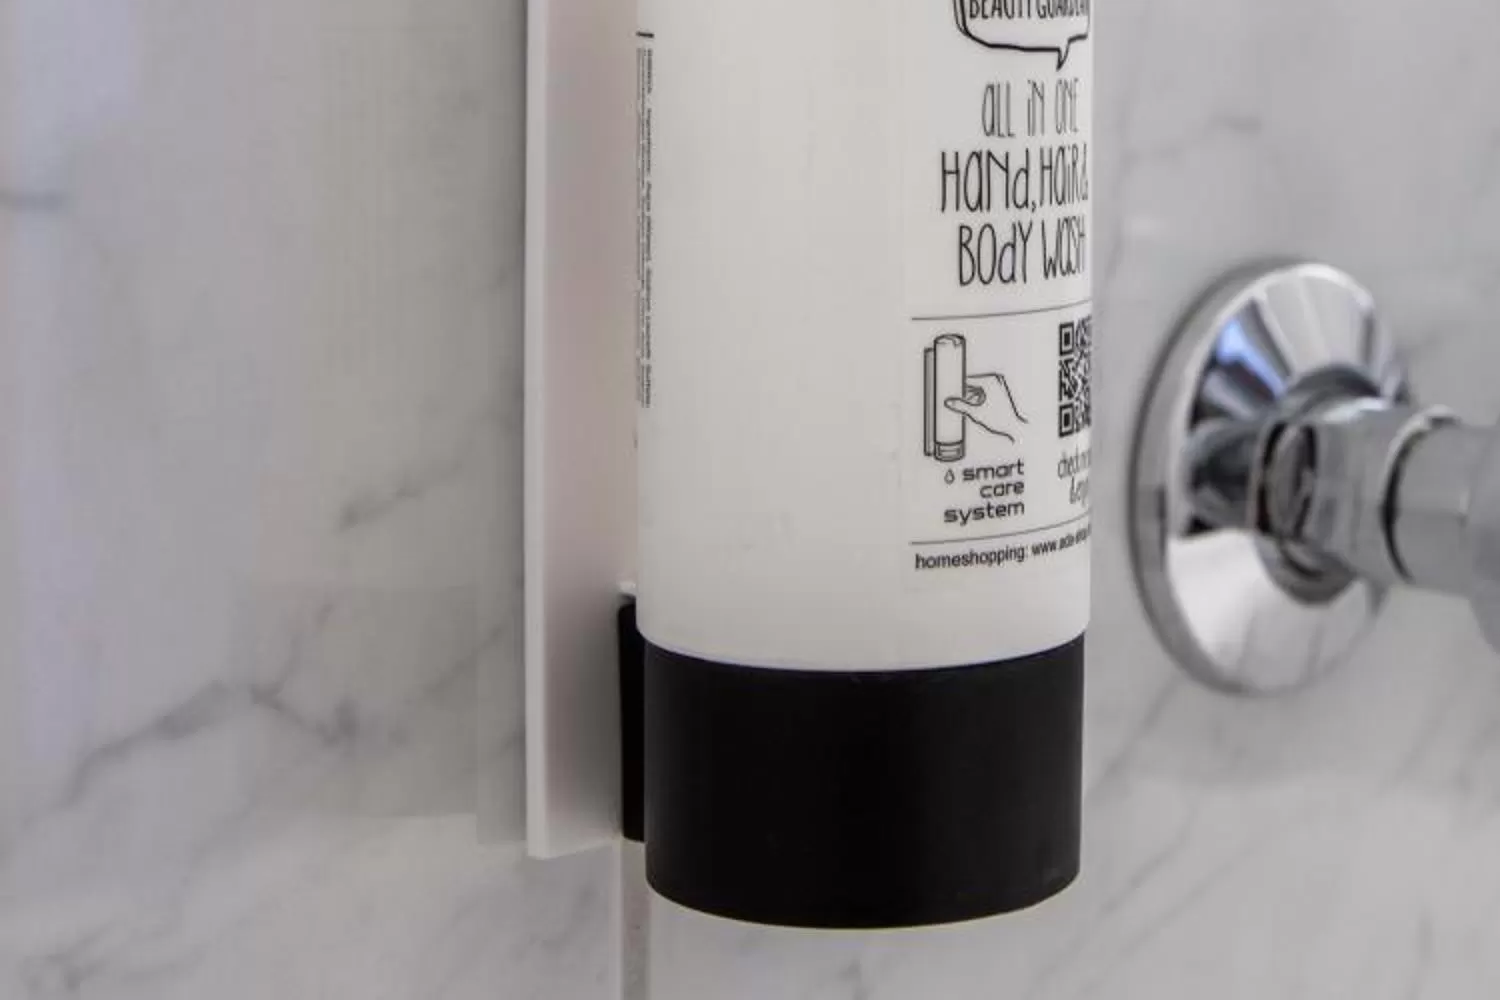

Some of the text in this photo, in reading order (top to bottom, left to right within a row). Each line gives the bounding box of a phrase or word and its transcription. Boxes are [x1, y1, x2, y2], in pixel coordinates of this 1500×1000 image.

[962, 459, 1025, 482] smart
[979, 479, 1025, 499] care
[943, 501, 1025, 526] system
[914, 546, 1029, 570] homeshopping:
